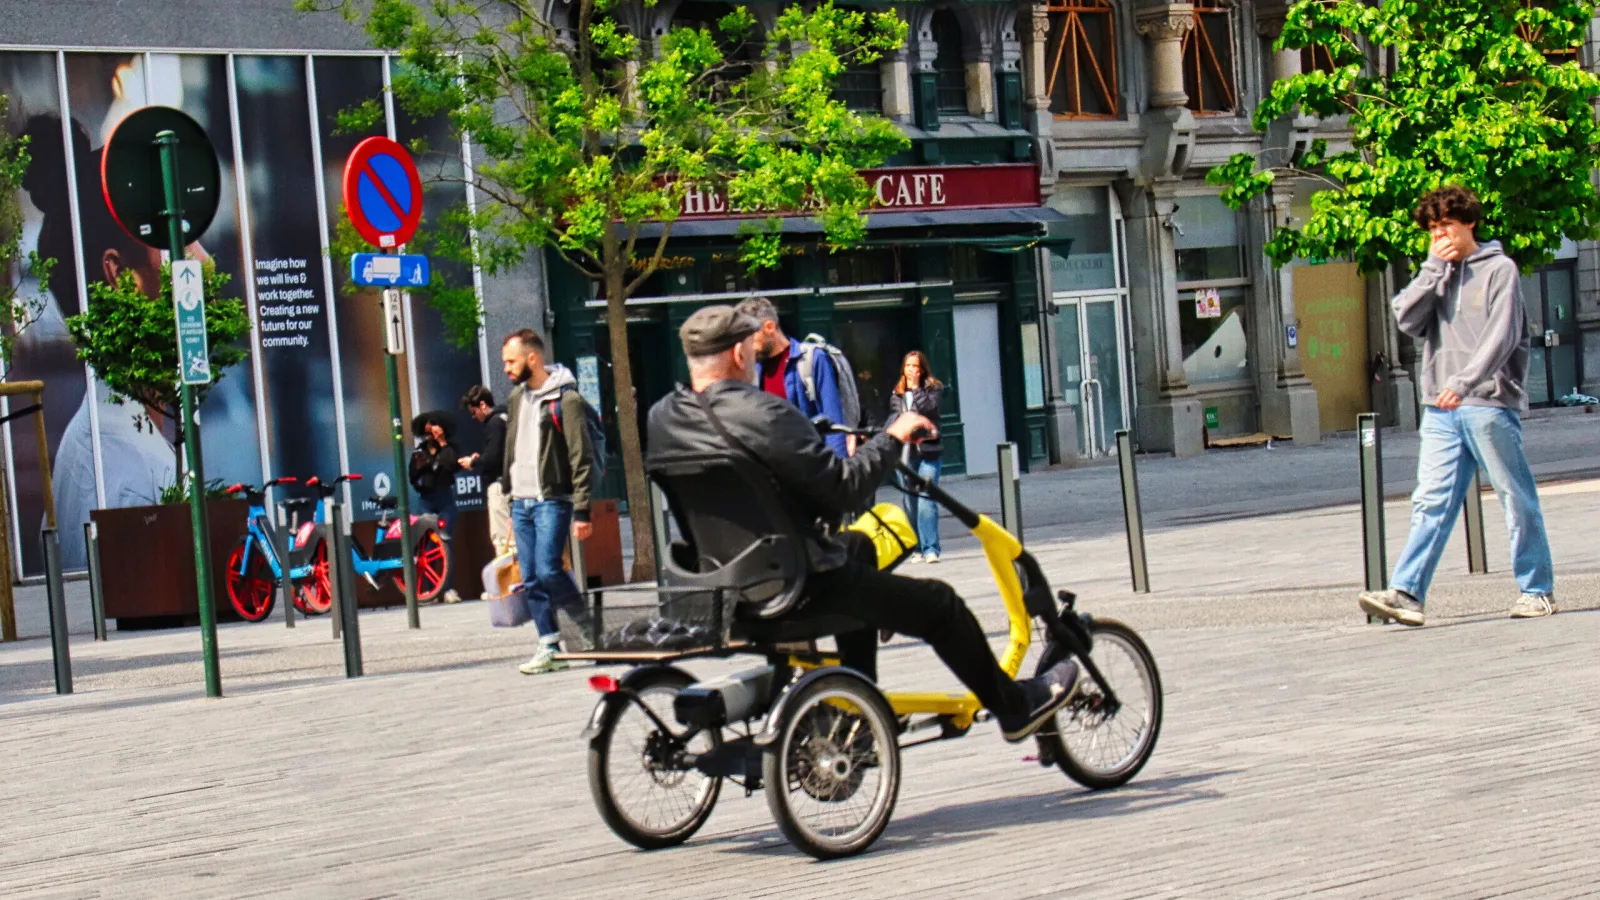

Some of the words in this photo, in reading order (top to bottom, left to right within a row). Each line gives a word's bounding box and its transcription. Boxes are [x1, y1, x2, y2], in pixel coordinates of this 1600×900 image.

[876, 174, 946, 206] CAFE
[255, 258, 288, 271] Imagine
[289, 258, 306, 268] how
[257, 275, 269, 285] we
[270, 273, 283, 284] will
[285, 273, 298, 284] live
[300, 273, 307, 283] &
[258, 289, 278, 300] work
[279, 288, 314, 302] together.
[390, 294, 398, 302] 12
[260, 304, 295, 317] Creating
[302, 305, 319, 314] new
[261, 320, 285, 331] future
[286, 319, 297, 330] for
[298, 320, 312, 329] our
[262, 335, 309, 347] community.
[456, 476, 481, 494] BPI
